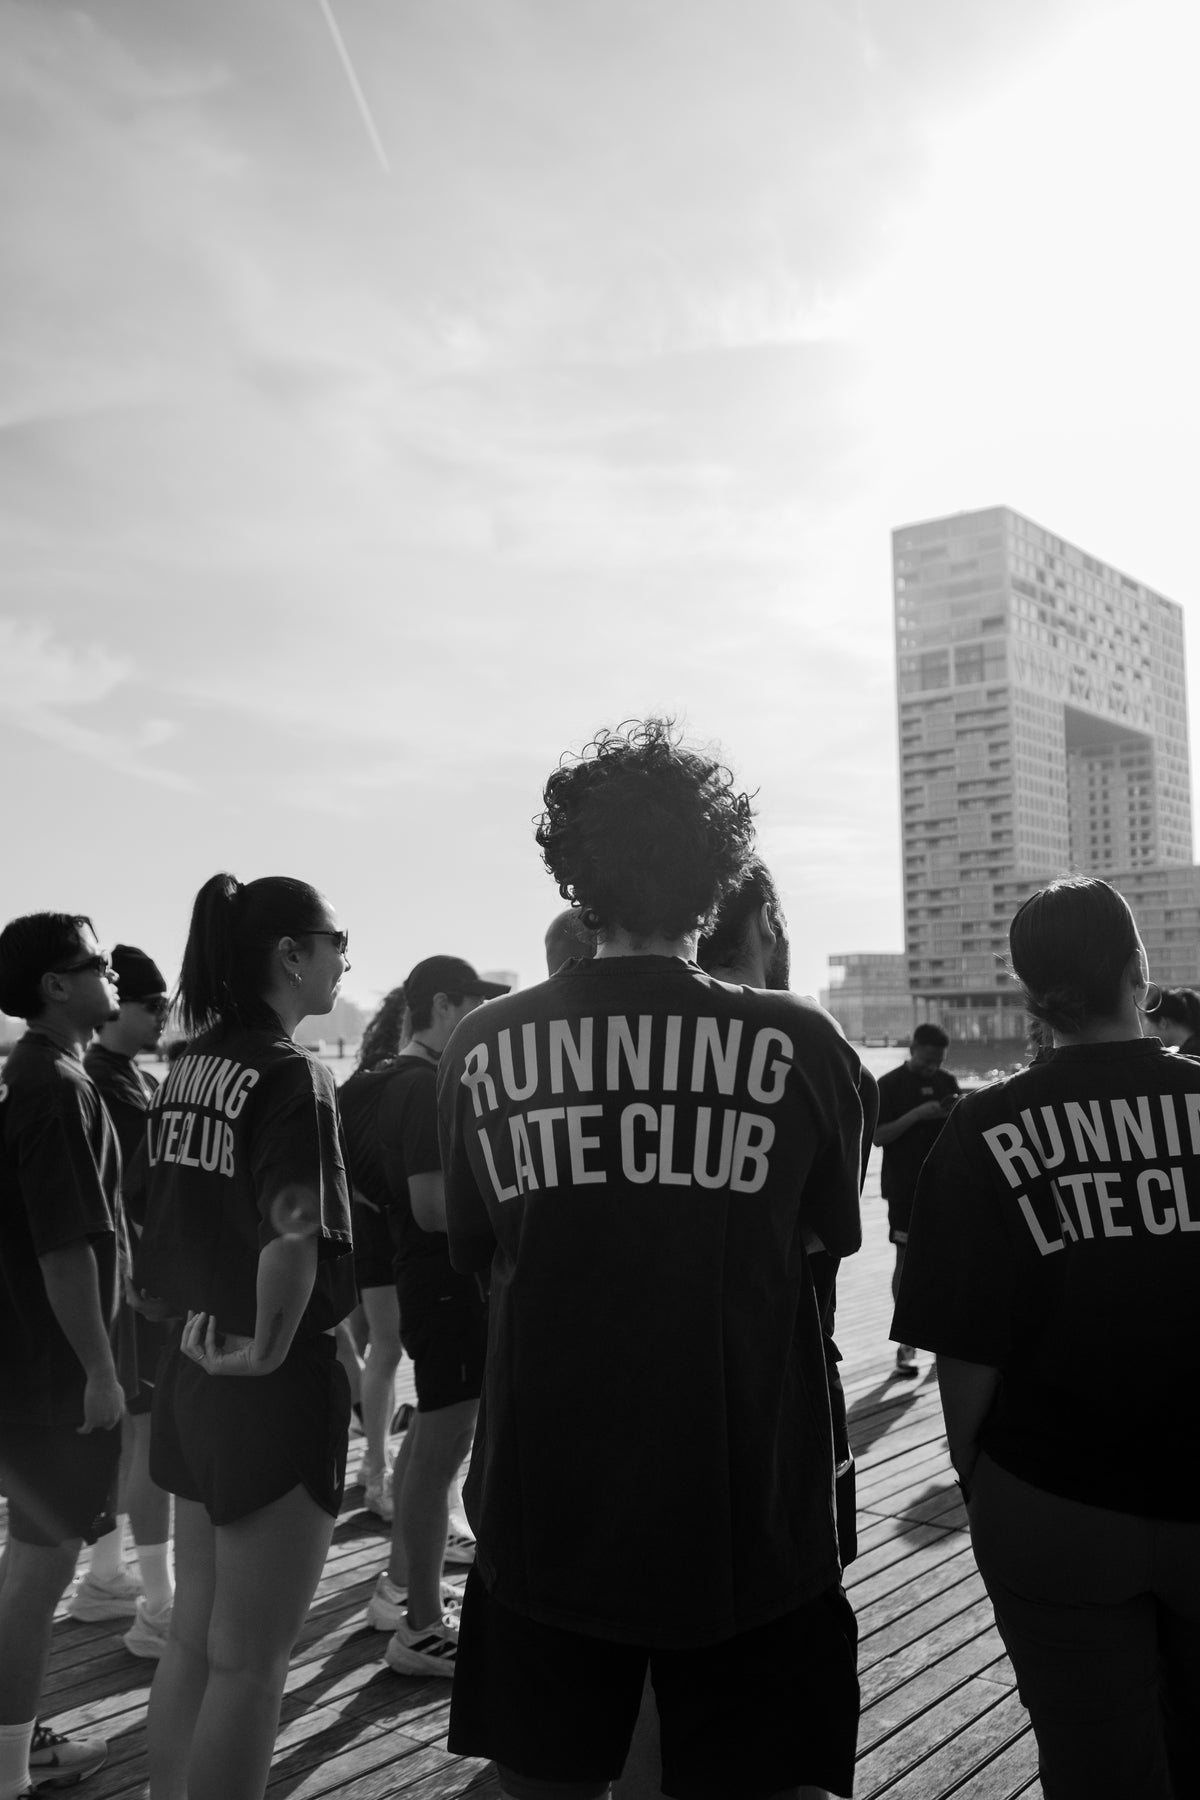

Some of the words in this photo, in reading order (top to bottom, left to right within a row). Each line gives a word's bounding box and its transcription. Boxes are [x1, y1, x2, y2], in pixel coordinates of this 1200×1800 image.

[461, 1015, 794, 1117] RUNNING
[147, 1111, 183, 1167] LTE
[477, 1104, 607, 1202] LATE
[620, 1102, 776, 1194] CLUB
[1017, 1172, 1133, 1256] LATE
